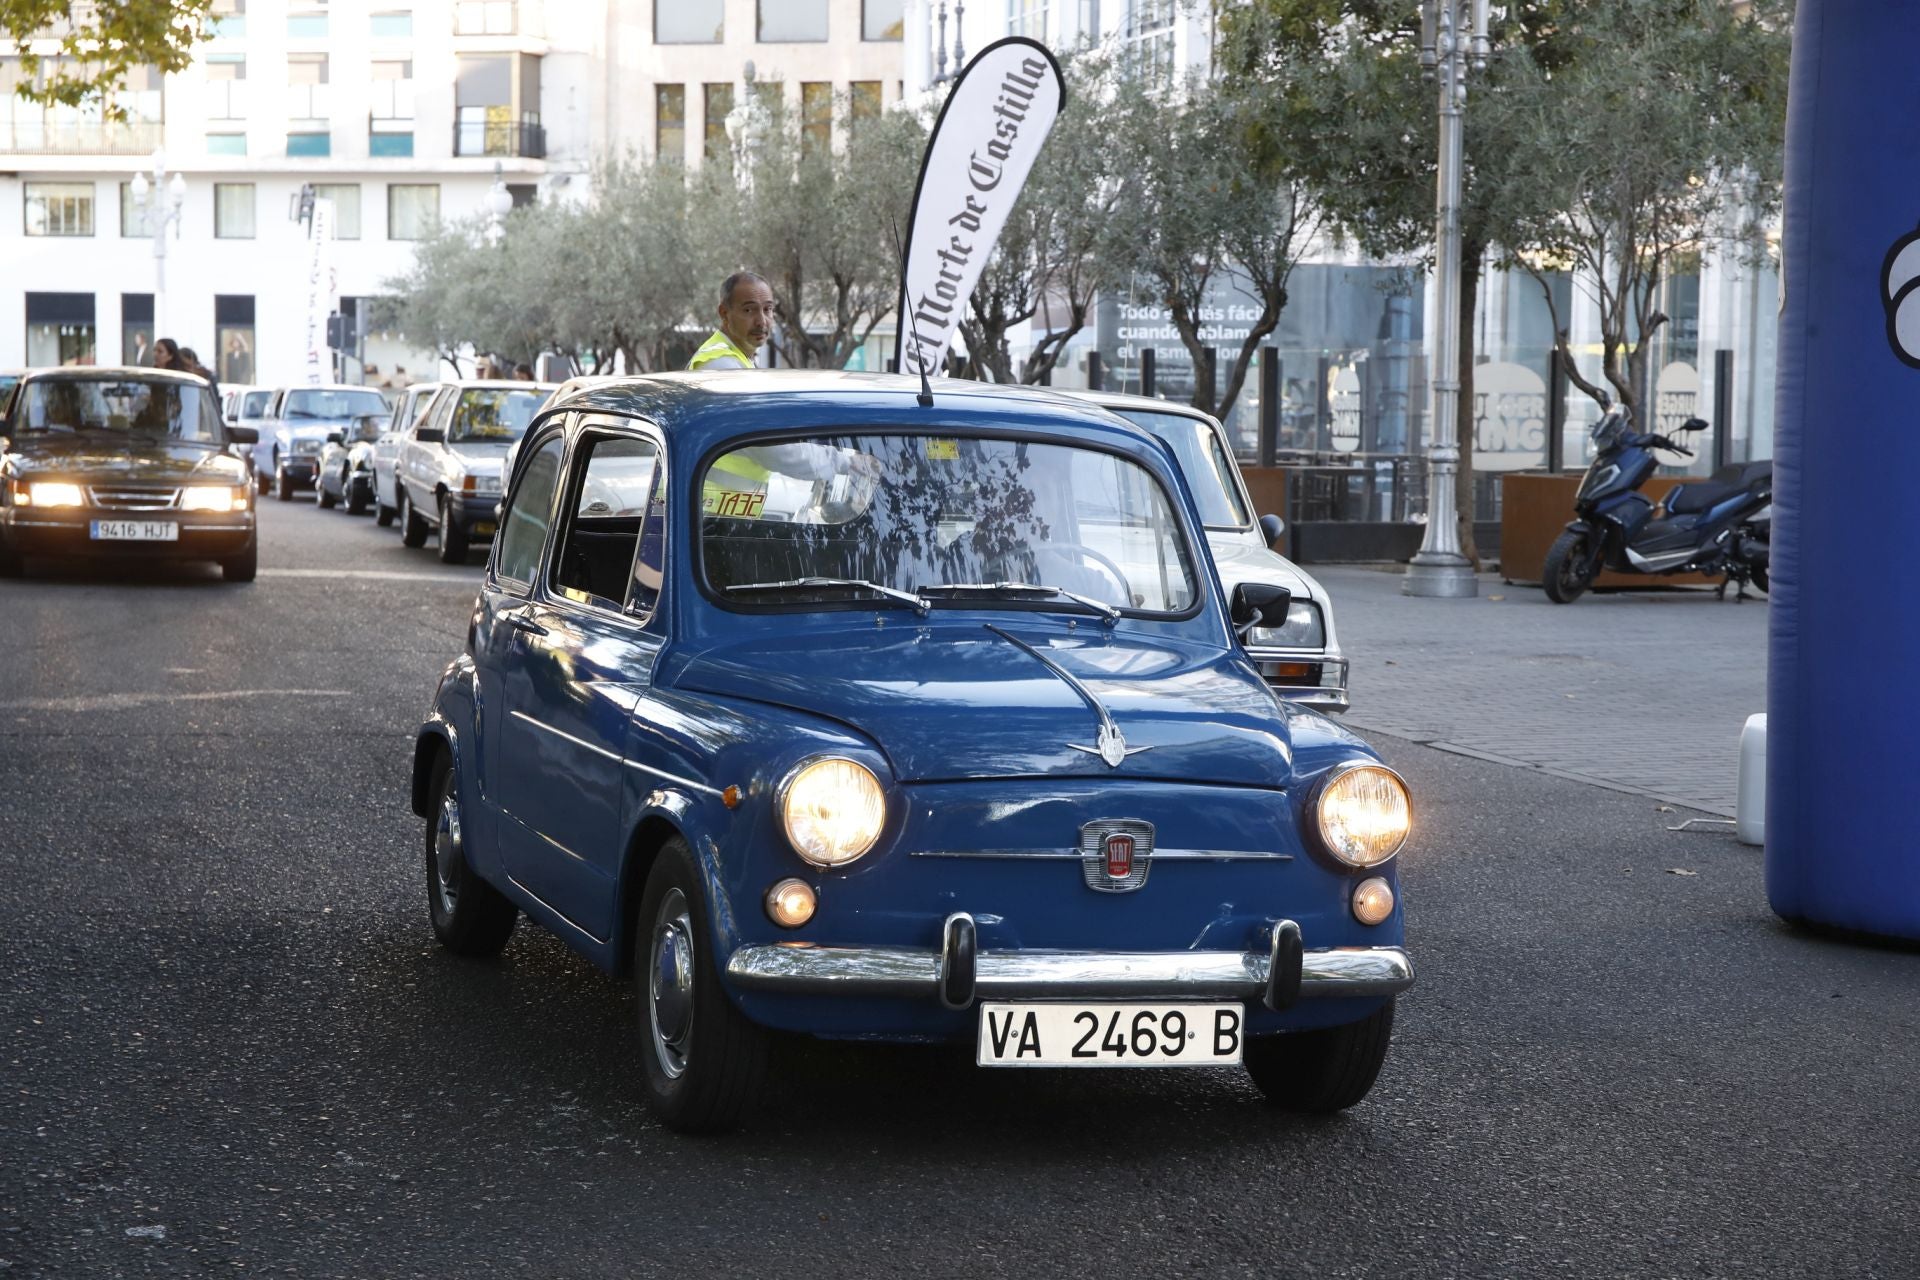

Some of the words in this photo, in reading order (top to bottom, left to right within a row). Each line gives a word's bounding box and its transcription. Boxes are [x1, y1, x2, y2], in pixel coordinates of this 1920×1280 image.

[914, 235, 973, 329] Norte
[948, 194, 988, 233] de
[968, 57, 1048, 192] Castilla
[1117, 304, 1161, 321] Todo
[1117, 323, 1181, 339] cuando
[1117, 343, 1135, 359] el
[1472, 418, 1545, 451] ING
[101, 523, 137, 537] 9416
[145, 523, 171, 537] HJT
[988, 1011, 1042, 1058] VA
[1071, 1010, 1187, 1058] 2469
[1213, 1009, 1240, 1056] B
